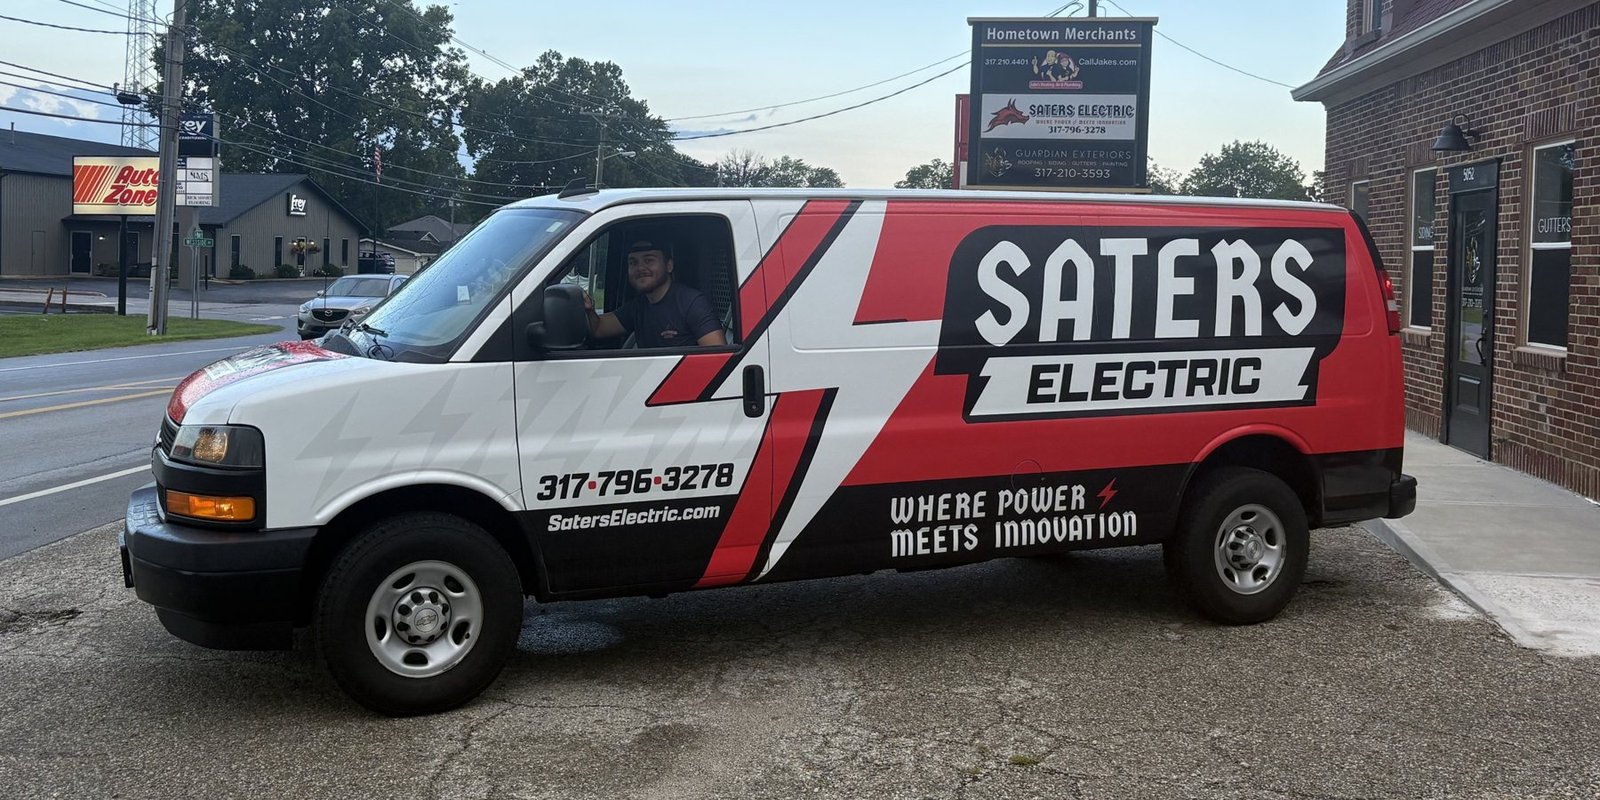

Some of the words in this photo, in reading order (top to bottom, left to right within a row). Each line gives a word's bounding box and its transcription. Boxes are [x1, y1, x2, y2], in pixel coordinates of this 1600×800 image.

[987, 27, 1059, 40] Hometown
[1065, 27, 1136, 40] Merchants
[984, 58, 1029, 66] 317.210.4401
[1078, 58, 1137, 66] CallJakes.com
[1029, 104, 1075, 118] SATERS
[1078, 104, 1135, 119] ELECTRIC
[1048, 126, 1106, 134] 317-796-3278
[1015, 149, 1068, 158] GUARDIAN
[1072, 150, 1132, 159] EXTERIORS
[1034, 168, 1111, 178] 317-210-3593
[1463, 167, 1475, 181] 5052
[103, 184, 158, 206] Zone
[1537, 216, 1572, 234] GUTTERS
[973, 237, 1318, 347] SATERS
[1026, 356, 1262, 404] ELECTRIC
[890, 490, 987, 525] WHERE
[997, 484, 1086, 516] POWER
[547, 504, 720, 532] SatersElectric.com
[890, 523, 979, 557] MEETS
[994, 510, 1137, 548] INNOVATION
